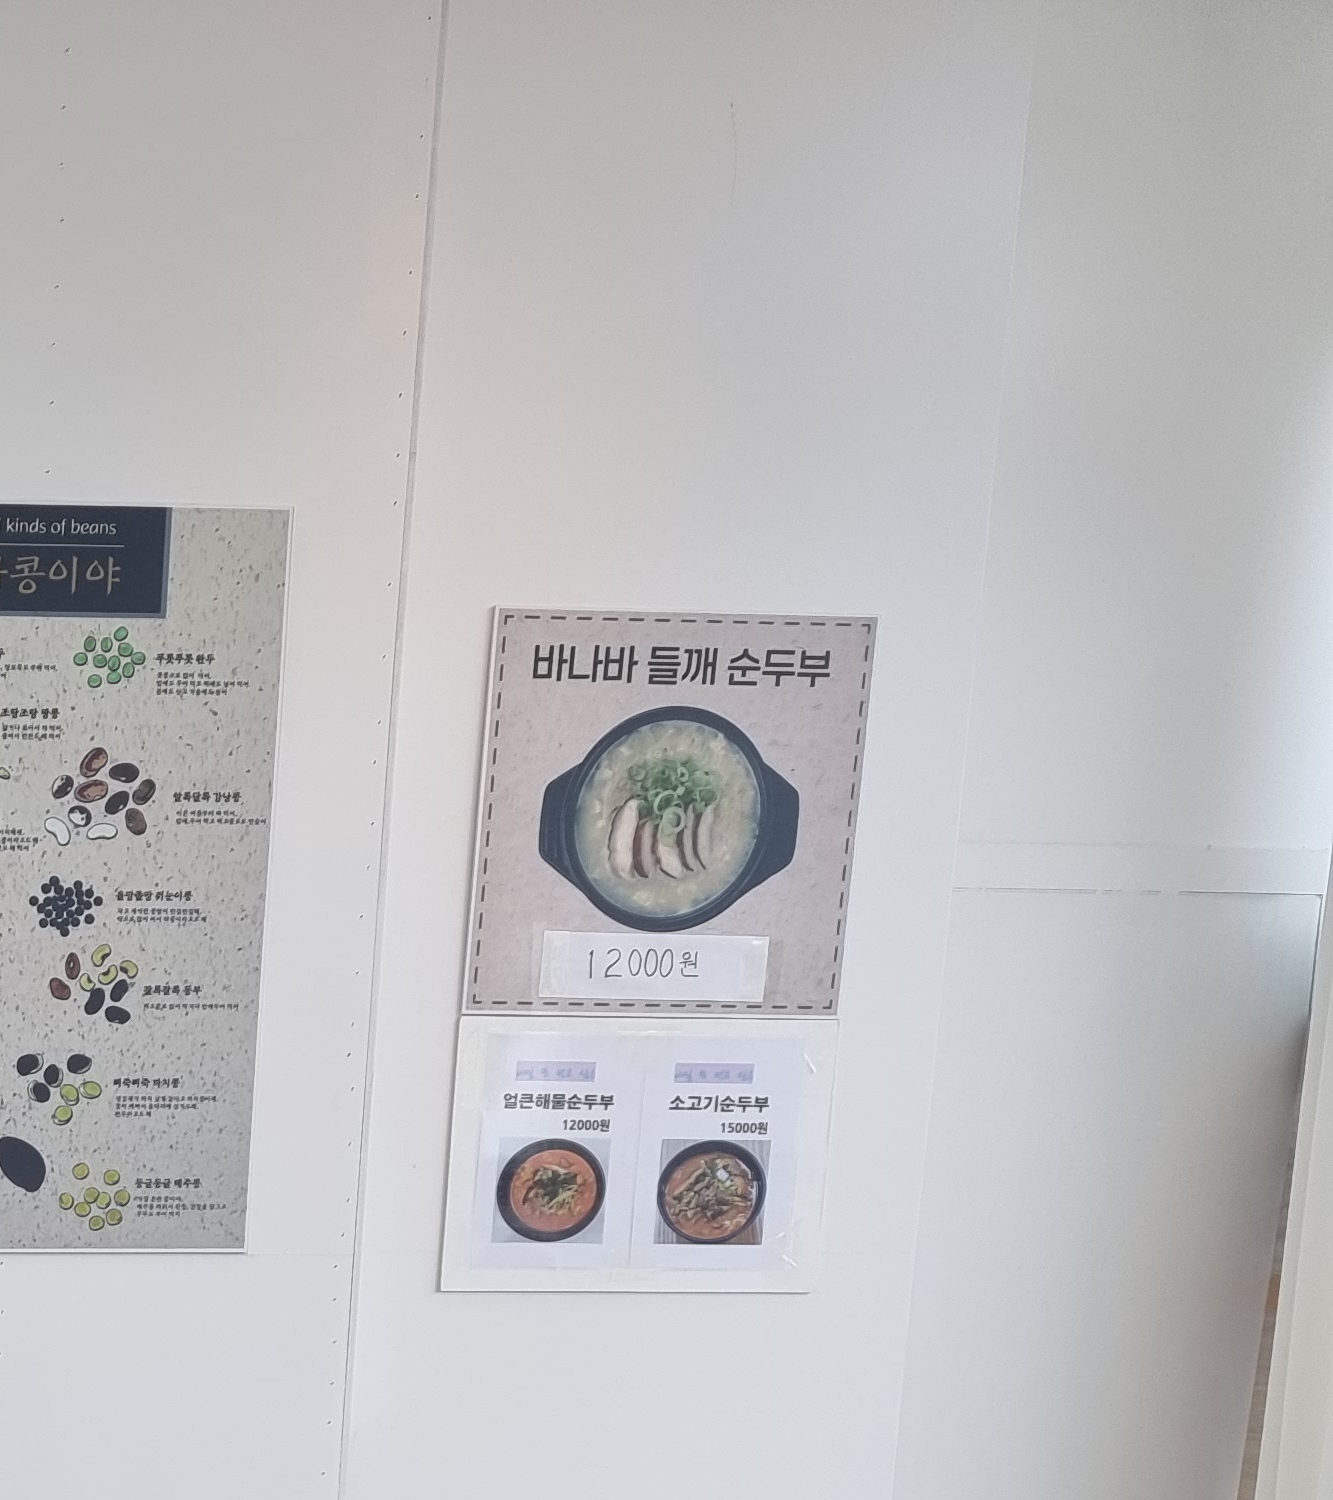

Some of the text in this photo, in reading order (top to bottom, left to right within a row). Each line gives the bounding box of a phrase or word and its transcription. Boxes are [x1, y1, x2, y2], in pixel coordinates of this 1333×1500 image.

[6, 517, 46, 534] kinds
[50, 518, 66, 536] of
[71, 519, 117, 535] beans
[532, 643, 832, 687] 바나바 들깨 순두부
[588, 948, 701, 981] 12000원
[503, 1092, 615, 1111] 얼큰해물순두부
[668, 1095, 770, 1113] 소고기순두부
[562, 1118, 611, 1133] 12000원
[720, 1121, 769, 1136] 15000원
